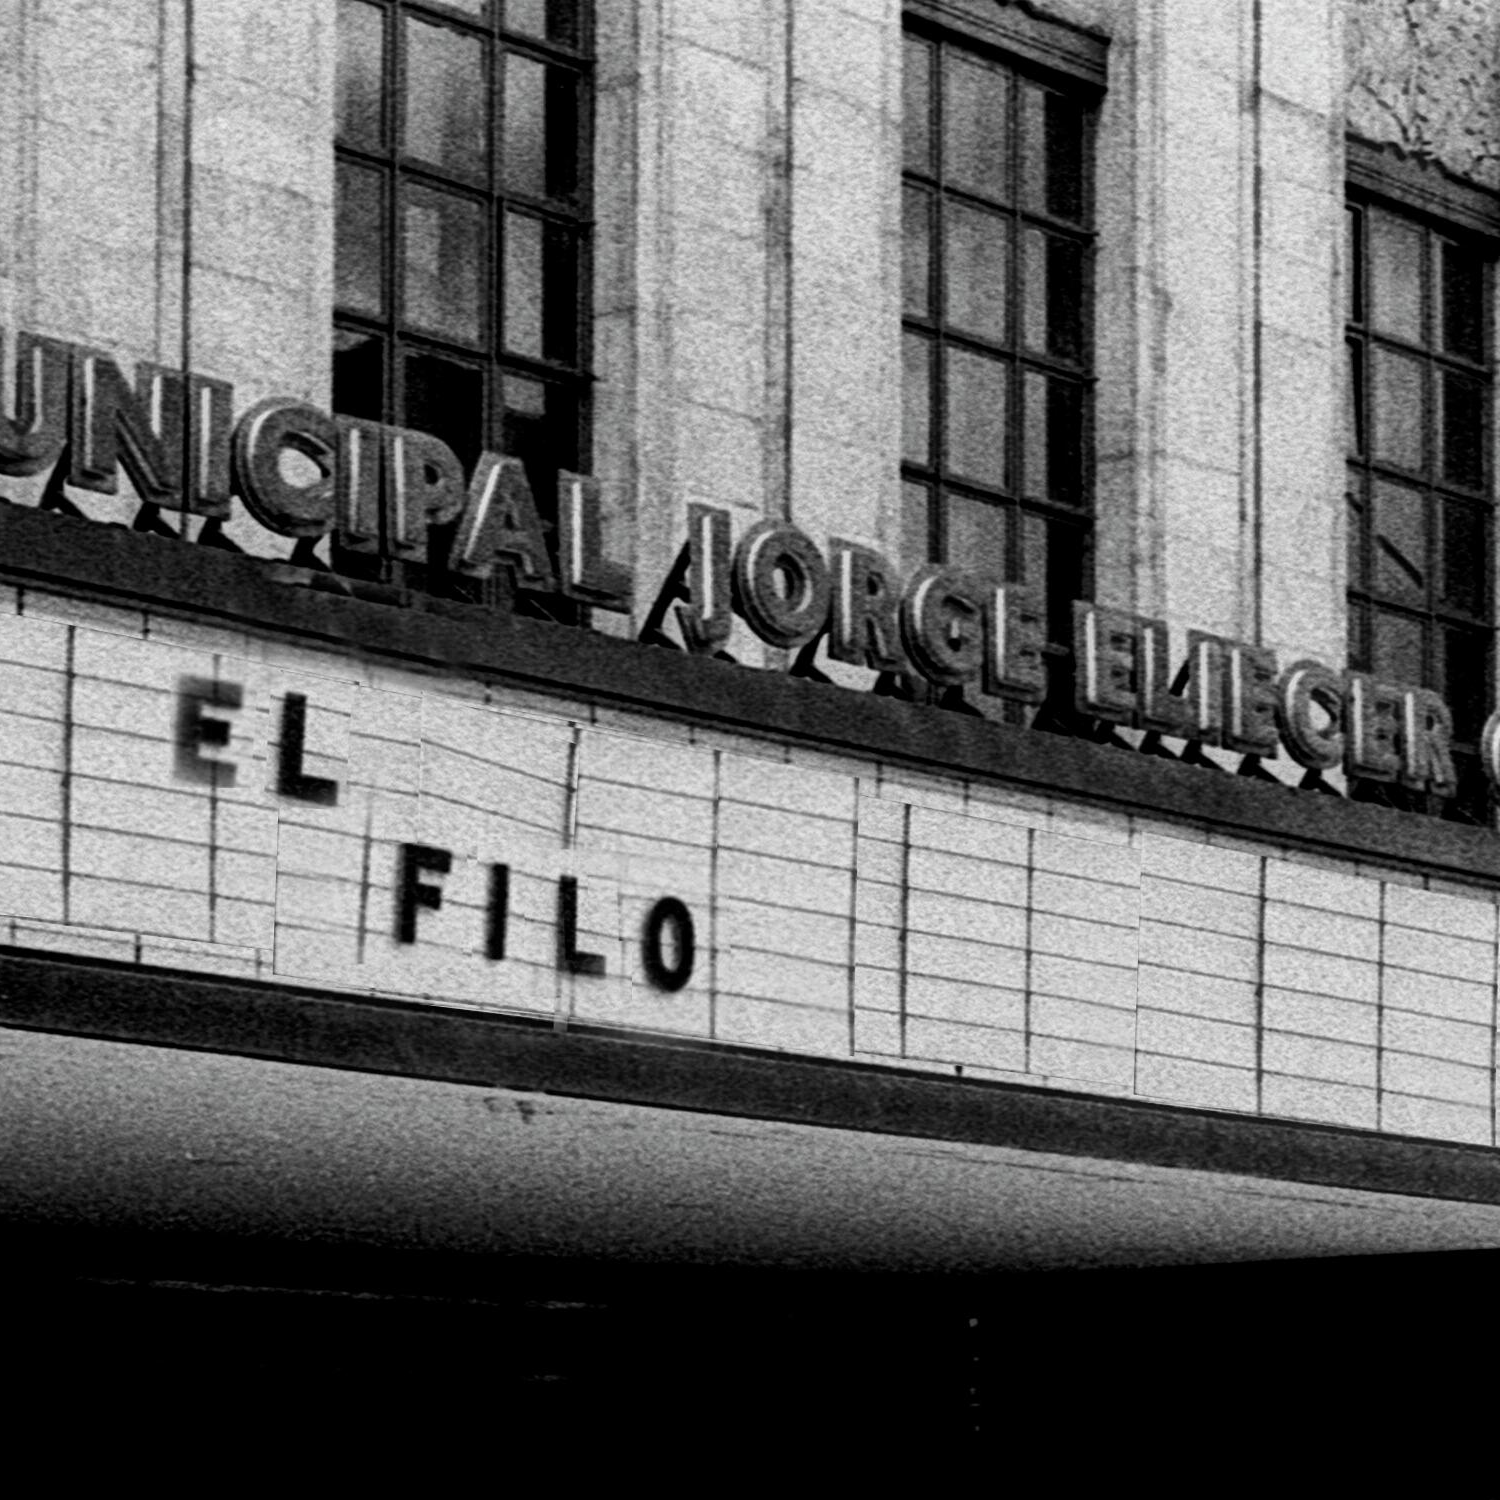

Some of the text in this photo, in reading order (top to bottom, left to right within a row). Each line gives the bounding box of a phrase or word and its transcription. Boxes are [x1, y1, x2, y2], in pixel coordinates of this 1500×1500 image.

[674, 501, 1049, 706] JORGE
[1073, 598, 1457, 797] ELIECER
[172, 673, 339, 807] EL
[395, 841, 695, 993] FILO
